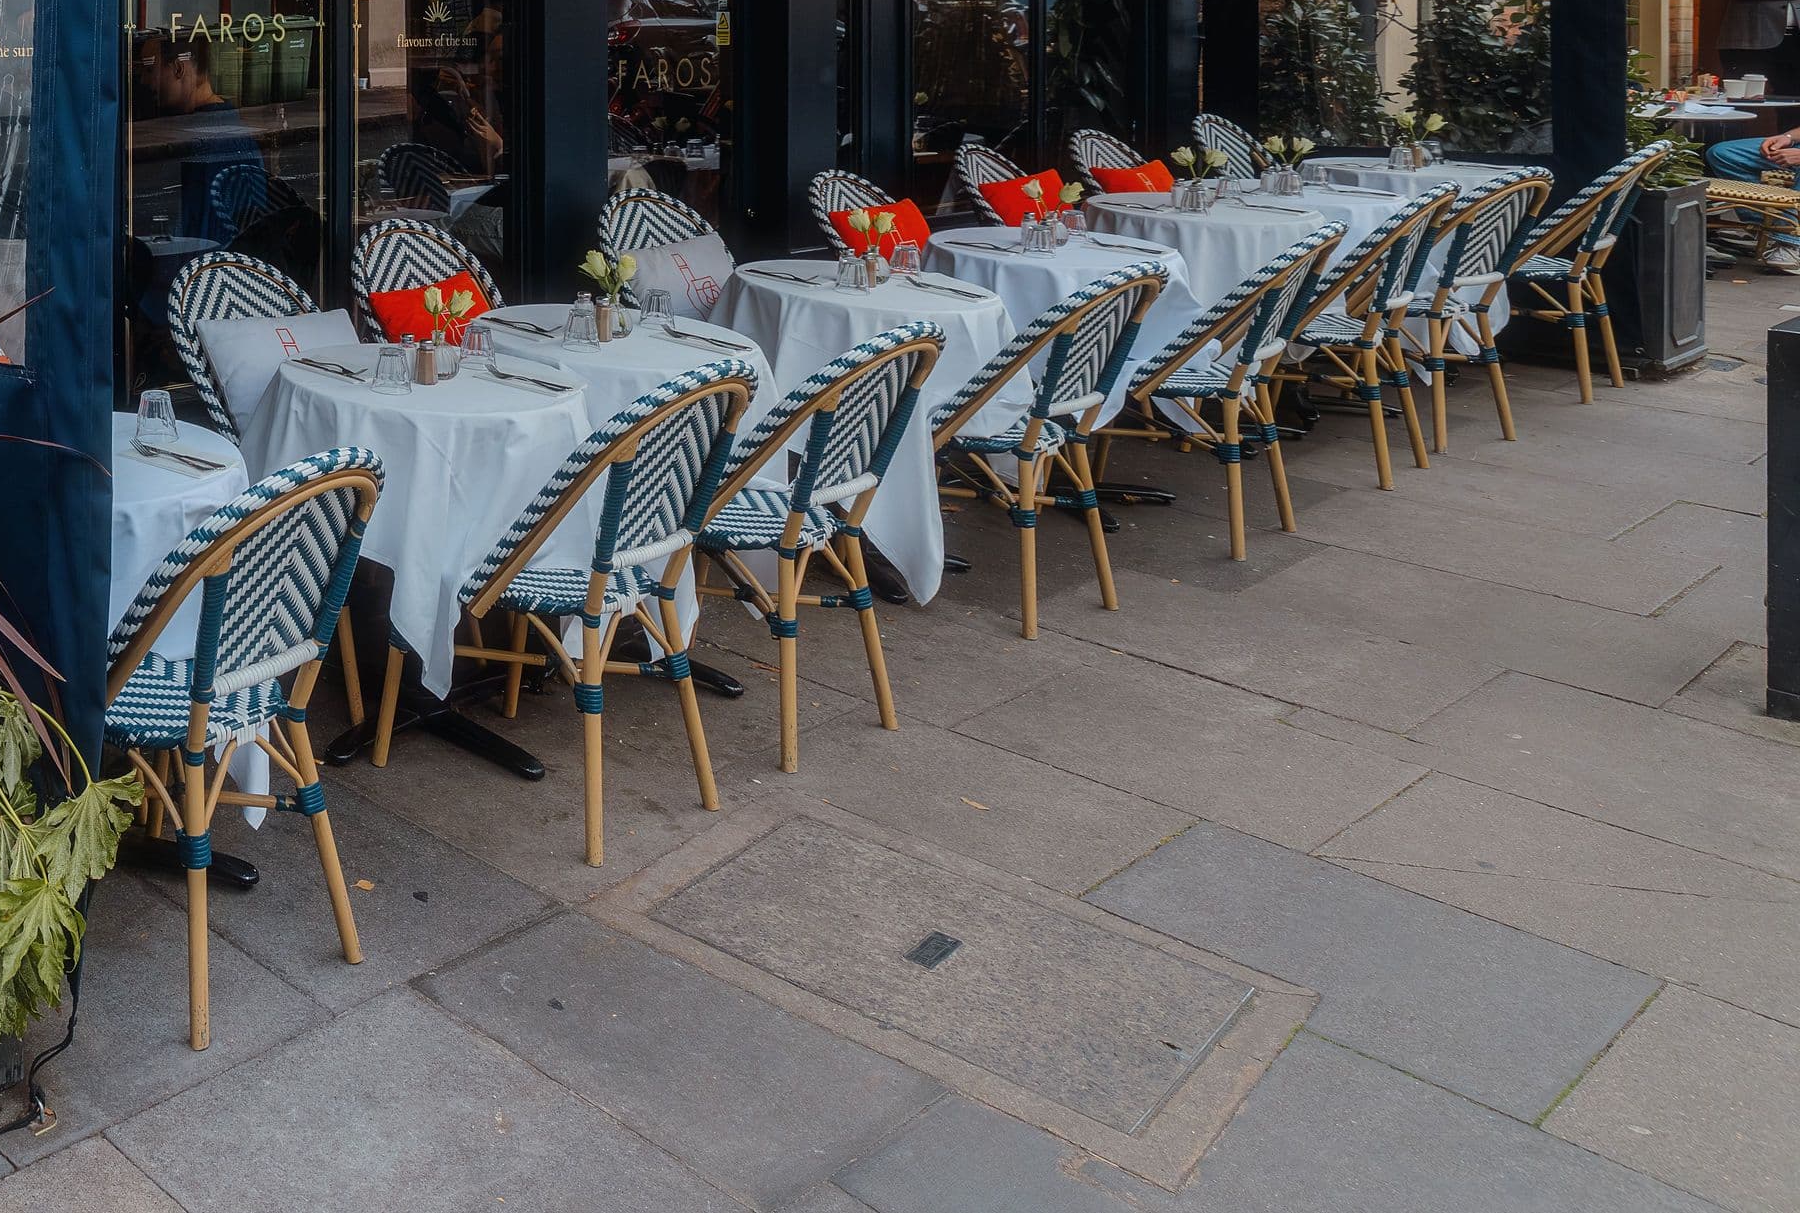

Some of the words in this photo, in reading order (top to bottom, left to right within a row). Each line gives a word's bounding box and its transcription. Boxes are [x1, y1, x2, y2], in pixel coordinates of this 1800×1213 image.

[171, 13, 286, 43] FAROS
[397, 33, 433, 48] flavours
[434, 33, 446, 47] of
[446, 33, 461, 47] the
[462, 37, 478, 46] sun
[618, 57, 711, 89] FAROS
